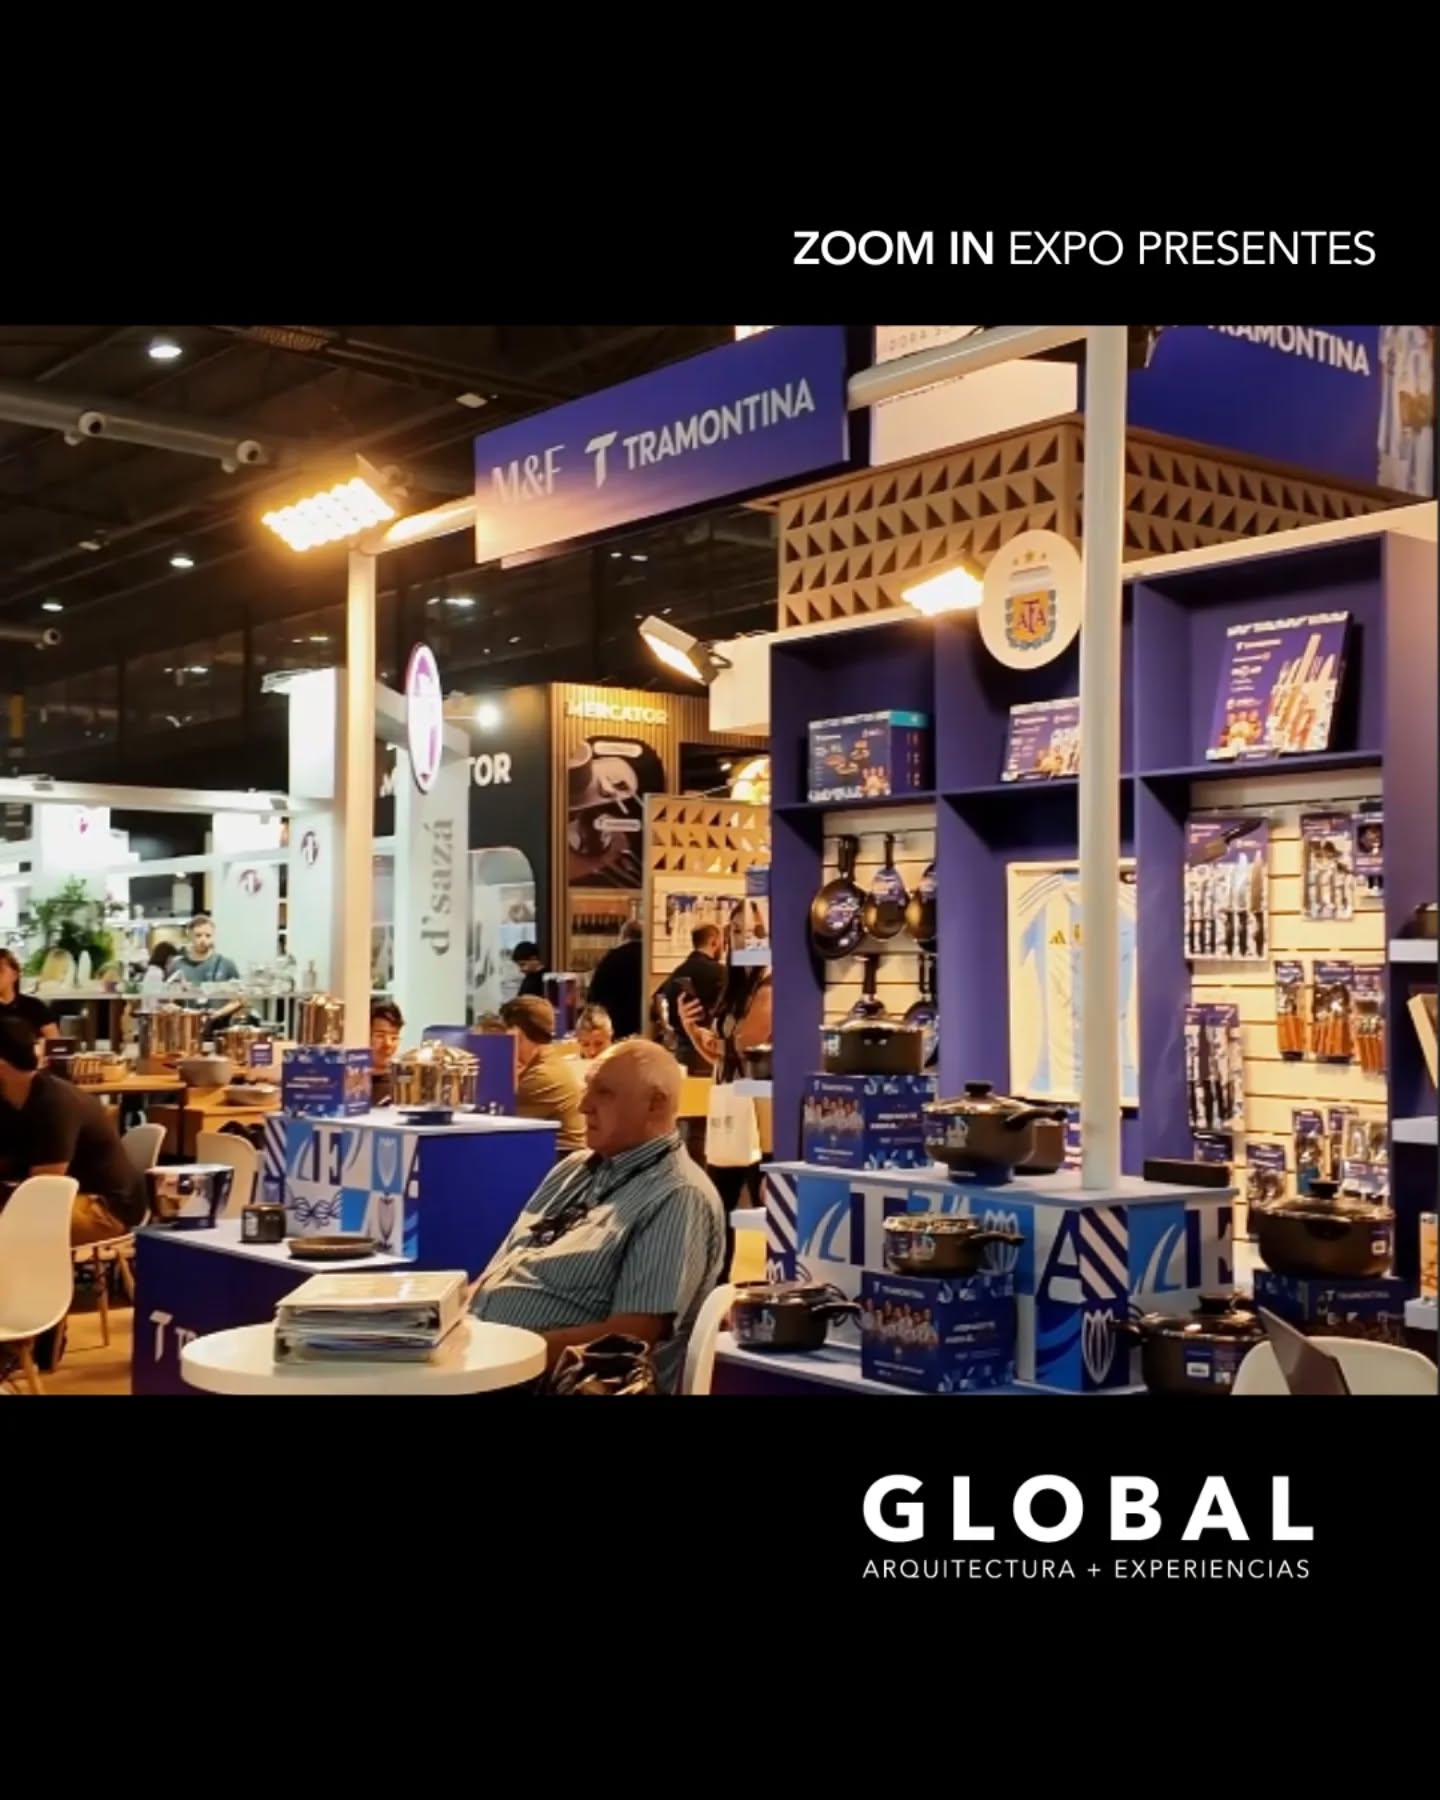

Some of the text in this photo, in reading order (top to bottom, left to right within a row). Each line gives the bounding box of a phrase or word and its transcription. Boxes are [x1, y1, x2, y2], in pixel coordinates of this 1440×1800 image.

[1206, 325, 1370, 376] MONTINA
[492, 446, 565, 501] M&F
[622, 378, 815, 470] TRAMONTINA
[565, 702, 668, 724] MERCATOR
